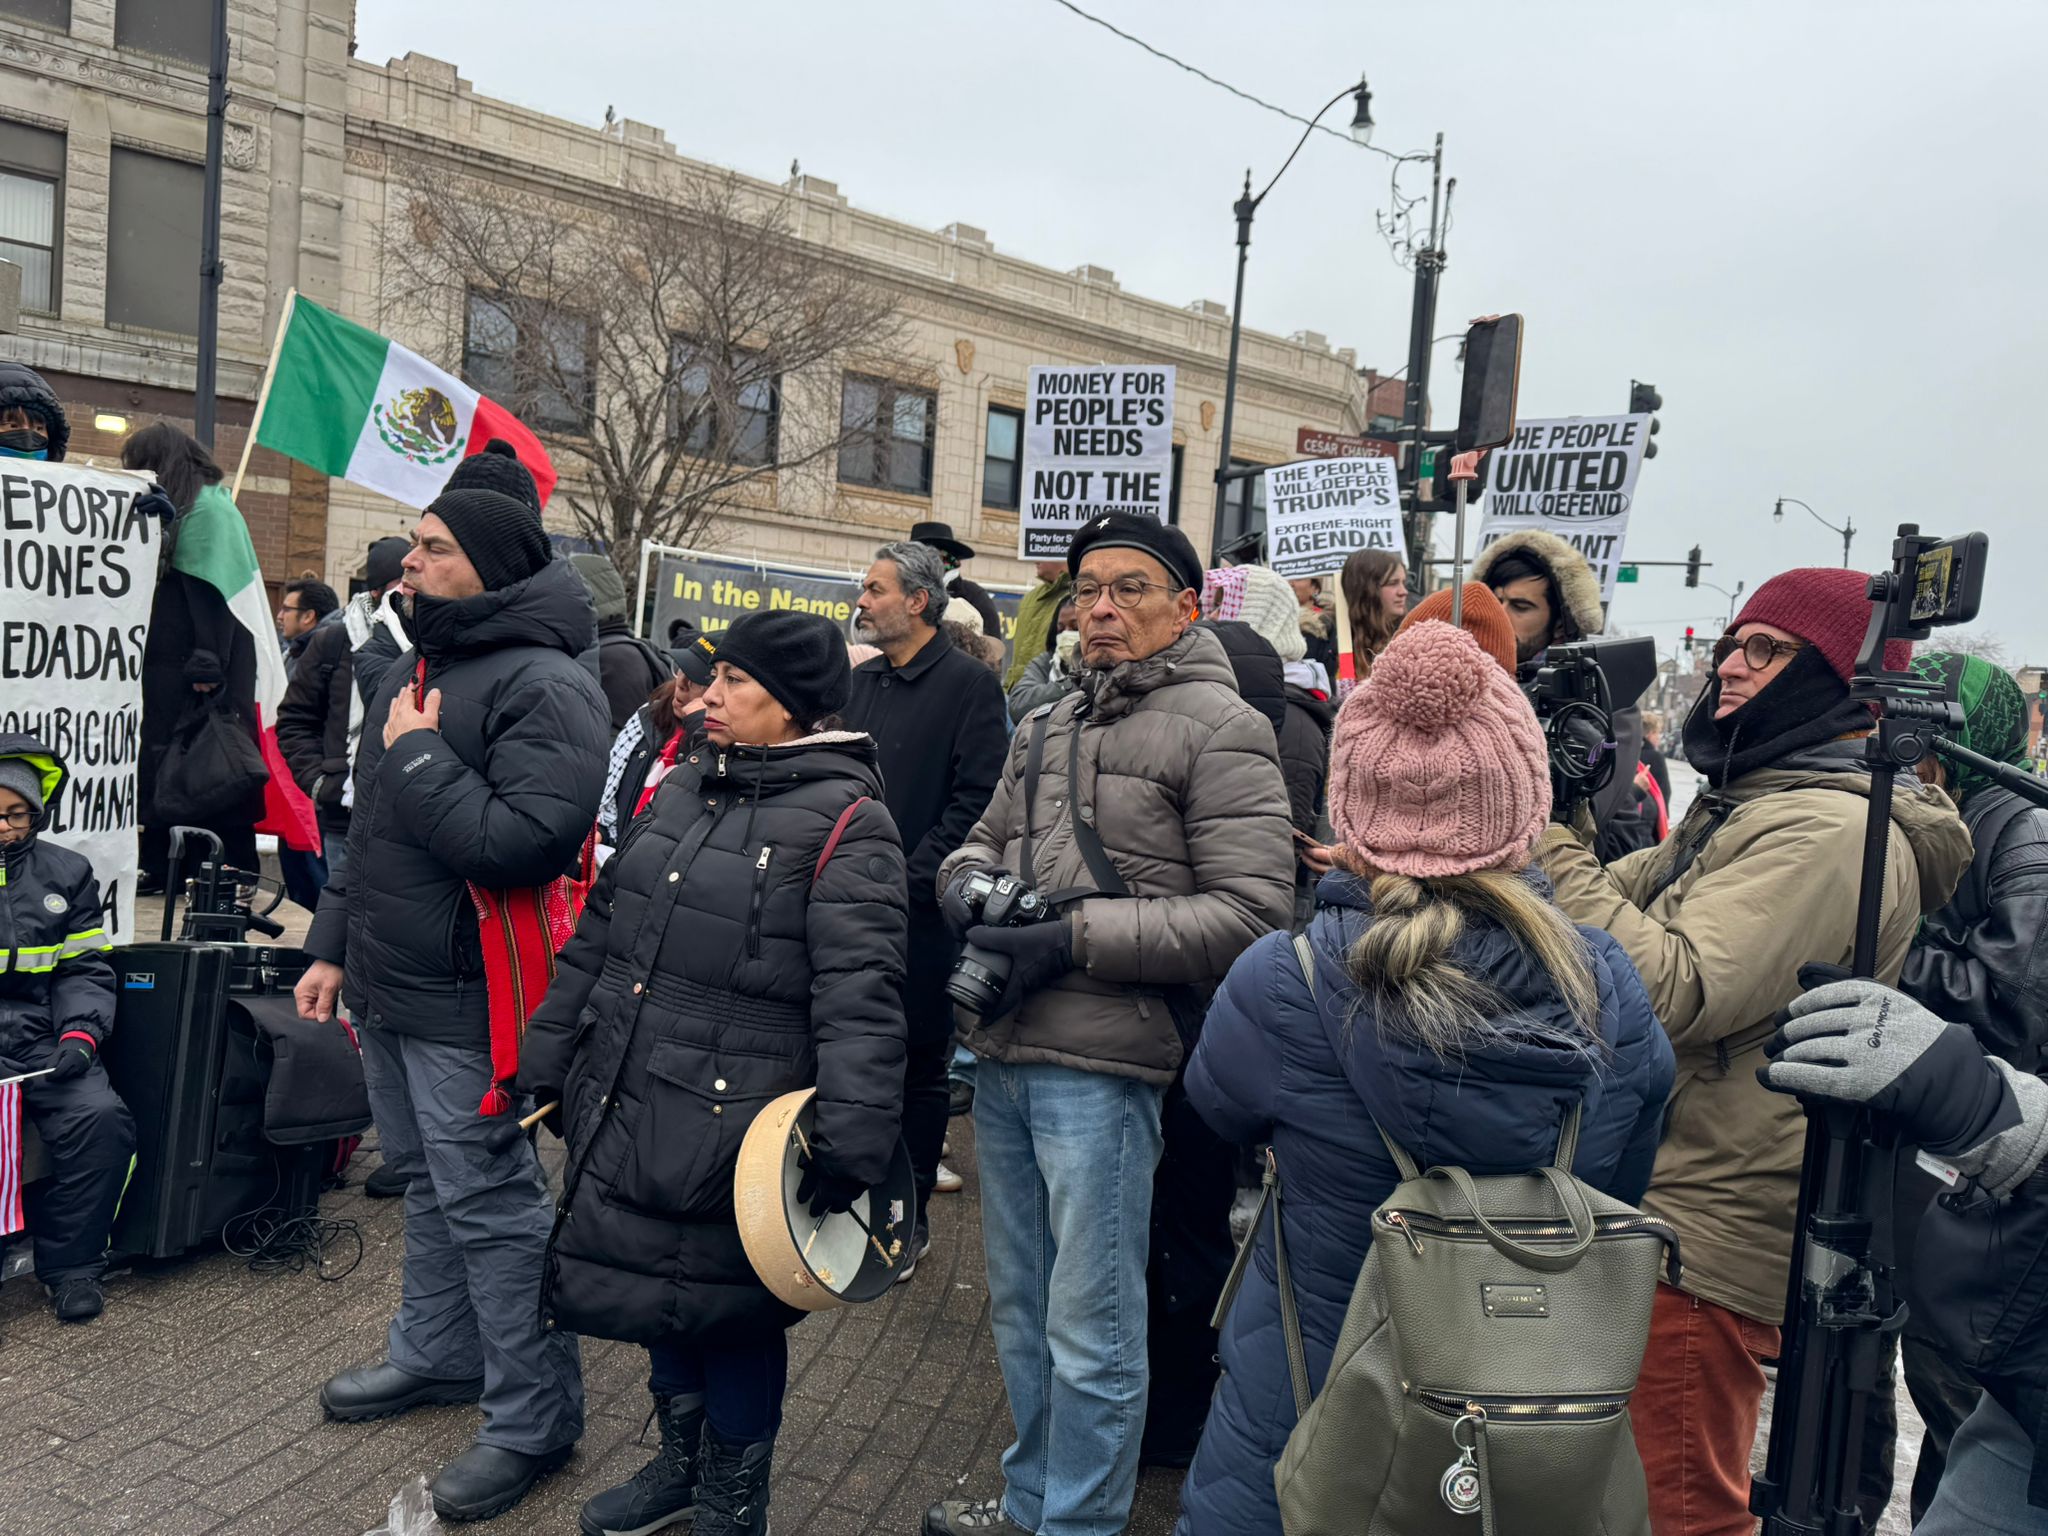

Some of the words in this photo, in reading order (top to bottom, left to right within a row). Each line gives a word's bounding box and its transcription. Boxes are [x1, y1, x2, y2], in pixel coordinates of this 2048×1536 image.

[1037, 372, 1116, 395] MONEY
[1121, 372, 1165, 395] FOR
[1035, 398, 1165, 426] PEOPLE'S
[1053, 428, 1143, 457] NEEDS
[1303, 438, 1339, 456] CESAR
[1503, 426, 1545, 450] HE
[1547, 421, 1639, 449] PEOPLE
[1272, 466, 1309, 484] THE
[1314, 462, 1388, 480] PEOPLE
[1273, 483, 1318, 497] WILL
[1321, 474, 1388, 491] DEFEAT
[1495, 450, 1628, 493] UNITED
[1033, 470, 1094, 501] NOT
[1102, 471, 1161, 502] THE
[0, 473, 149, 544] EPORTA
[1031, 503, 1070, 520] WAR
[1273, 487, 1391, 515] TRUMP'S
[1492, 494, 1536, 515] WILL
[1541, 493, 1622, 517] DEFEND
[1029, 532, 1051, 545] Party
[1052, 534, 1066, 543] for
[1275, 518, 1394, 536] EXTREME-RIGHT
[1275, 530, 1394, 557] AGENDA!
[3, 538, 131, 598] IONES
[673, 572, 703, 601] In
[712, 579, 761, 610] the
[769, 587, 850, 621] Name
[2, 621, 146, 681] EDADAS
